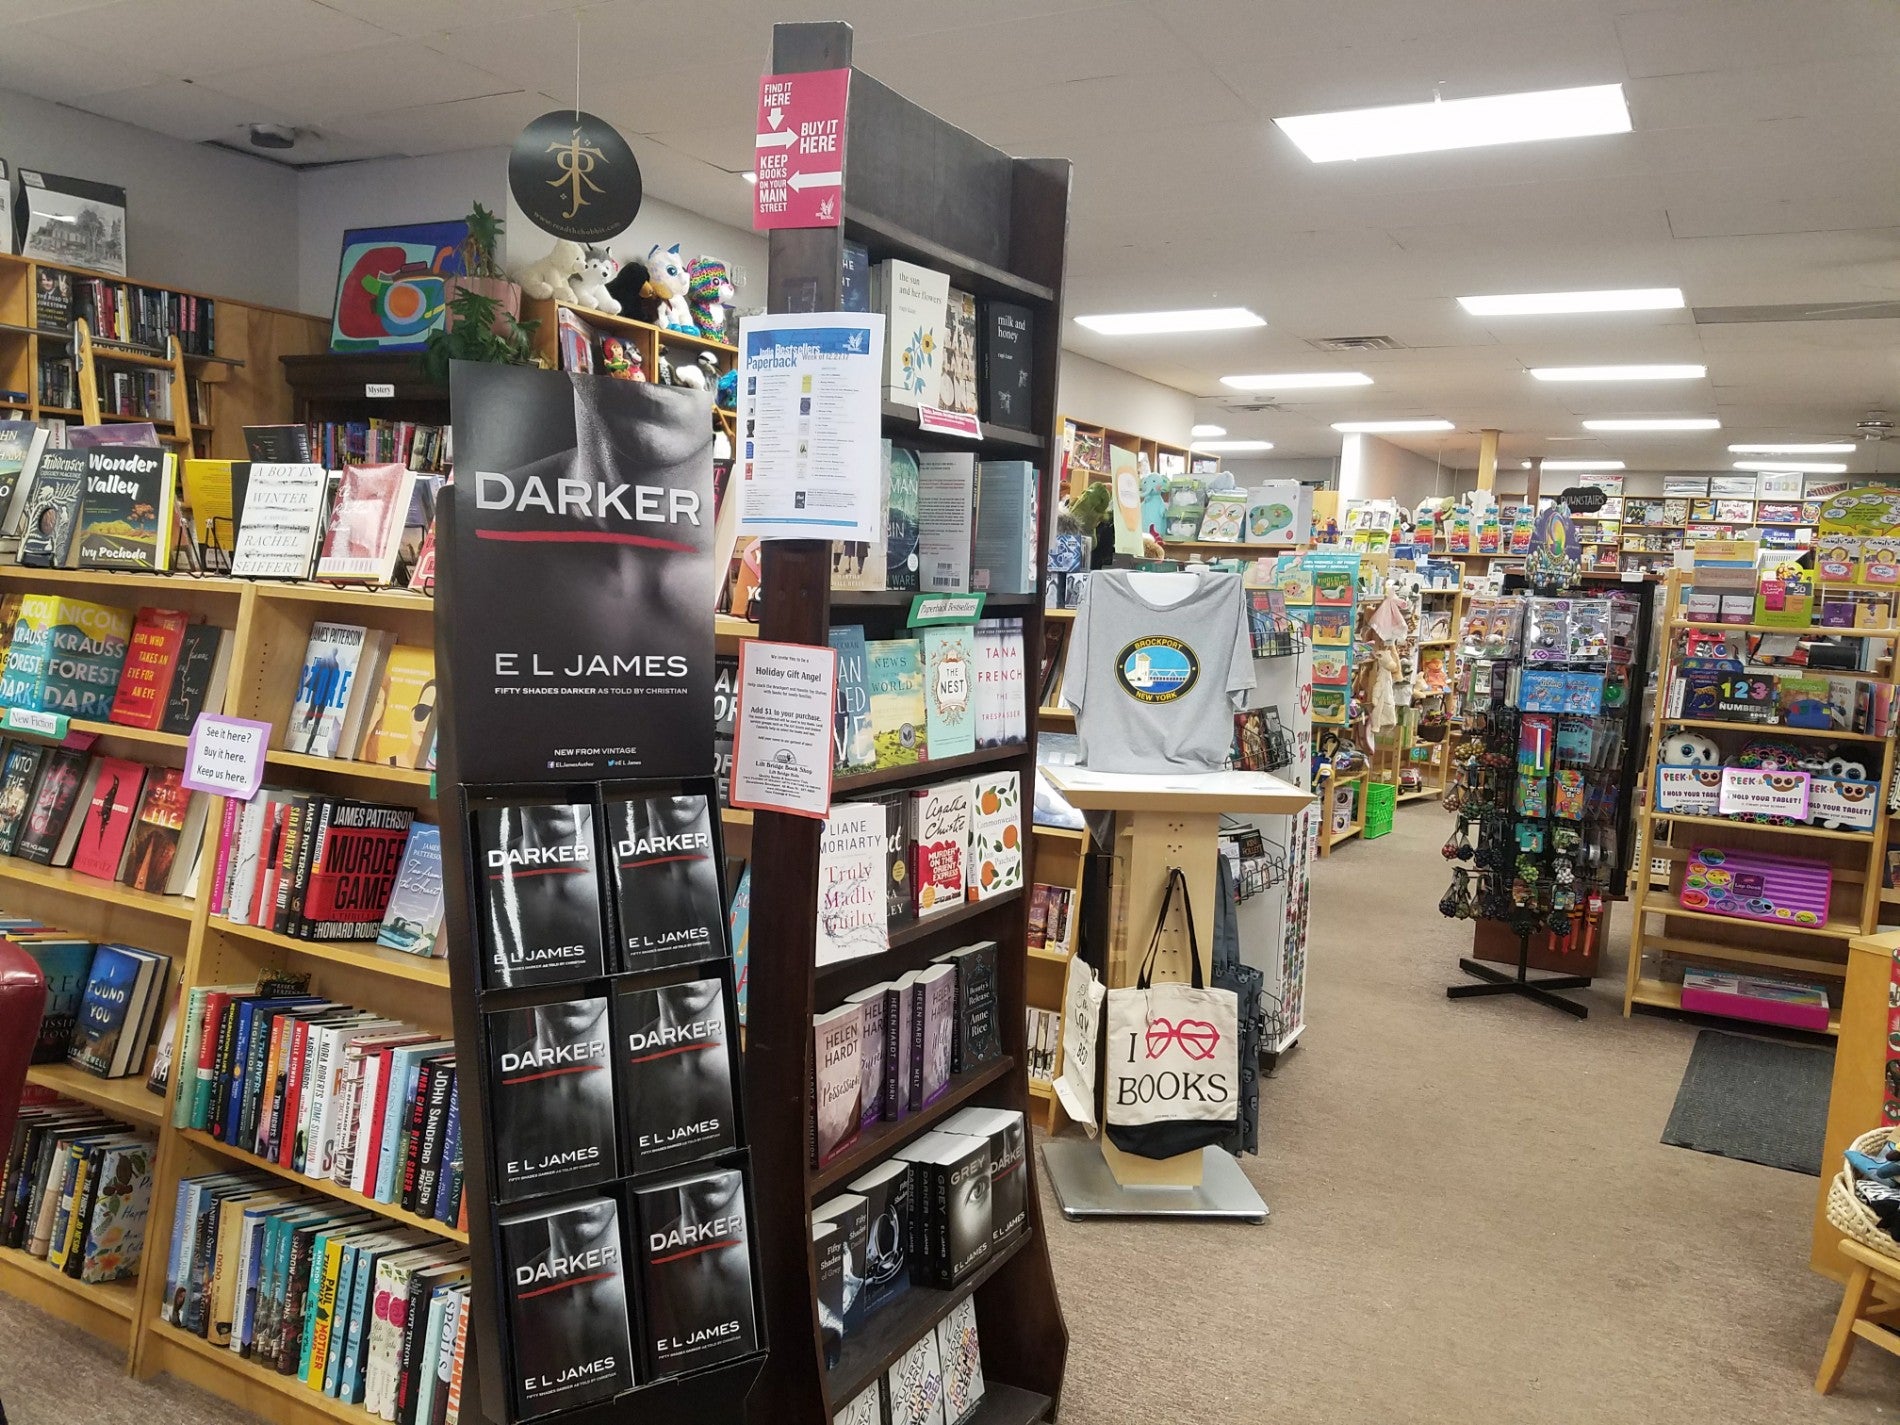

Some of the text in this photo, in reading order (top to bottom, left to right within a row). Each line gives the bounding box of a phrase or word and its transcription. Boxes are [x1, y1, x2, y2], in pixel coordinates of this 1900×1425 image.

[764, 82, 792, 94] FIND IT
[764, 93, 791, 107] HERE
[801, 120, 838, 136] BUY IT
[800, 134, 836, 154] HERE
[760, 154, 788, 168] KEEP
[760, 168, 787, 179] BOOKS
[760, 180, 786, 188] ON YOUR
[760, 188, 786, 203] MAIN
[760, 202, 787, 213] STREET
[900, 272, 920, 286] the sun
[998, 327, 1018, 343] honey
[747, 356, 797, 371] Paperback
[368, 386, 391, 394] Mystery
[89, 453, 157, 474] Wonder
[87, 475, 139, 500] Valley
[252, 493, 308, 504] WINTER
[475, 472, 700, 526] DARKER
[1561, 495, 1605, 506] DOWNSTAIRS
[244, 536, 299, 546] RACHEL
[81, 547, 146, 562] Ivy Pochoda
[233, 562, 300, 574] SEIFFERT
[921, 602, 976, 614] Paperback Bestsellers
[54, 632, 124, 658] KRAUSS
[311, 628, 362, 646] JAMES PATTERSON
[1134, 638, 1184, 649] BROCKPORT
[986, 647, 1016, 659] TANA
[496, 654, 688, 677] E L JAMES
[874, 657, 907, 668] NEWS
[48, 658, 120, 686] FOREST
[127, 668, 154, 681] EYE FOR
[756, 667, 822, 683] Holiday Gift Angel
[946, 668, 959, 676] THE
[978, 670, 1023, 682] FRENCH
[131, 686, 156, 700] AN EYE
[871, 680, 912, 692] WORLD
[940, 679, 965, 694] NEST
[43, 686, 112, 716] DARK
[1136, 690, 1177, 701] NEW YORK
[751, 706, 763, 714] Add
[795, 712, 821, 722] purchase.
[982, 711, 1021, 721] TRESPASSER
[1719, 702, 1768, 713] NUMBERS
[12, 710, 54, 730] New Fiction
[206, 727, 251, 743] See it here?
[204, 747, 246, 762] Buy it here.
[197, 766, 246, 784] Keep us here.
[1562, 785, 1581, 794] Crazy
[1733, 793, 1749, 801] HOLD
[1772, 796, 1801, 805] TABLET!
[334, 806, 414, 830] JAMES PATTERSON
[830, 820, 866, 836] LIANE
[285, 807, 300, 870] SARA PARETSKY
[295, 803, 315, 889] JAMES PATTERSON
[618, 832, 709, 857] DARKER
[820, 836, 881, 854] MORIARTY
[488, 845, 590, 867] DARKER
[928, 849, 955, 860] MURDER
[825, 861, 872, 883] Truly
[933, 864, 956, 873] ORIENT
[276, 878, 289, 909] FALLOUT
[1735, 882, 1746, 890] Lap
[825, 886, 875, 910] Madly
[823, 910, 876, 932] Guilty
[628, 927, 709, 948] E L JAMES
[493, 945, 585, 964] E L JAMES
[88, 980, 124, 1004] FOUND
[969, 992, 990, 1005] Release
[90, 1005, 111, 1023] YOU
[970, 1010, 988, 1025] Anne
[629, 1019, 722, 1051] DARKER
[825, 1022, 858, 1050] HELEN
[971, 1022, 988, 1038] Rice
[501, 1040, 606, 1072] DARKER
[825, 1039, 858, 1068] HARDT
[1128, 1033, 1138, 1062] I
[823, 1076, 860, 1107] Possession
[1117, 1072, 1228, 1105] BOOKS
[421, 1071, 448, 1164] JOHN SANDFORD
[404, 1067, 430, 1193] FINAL GIRLS RILEY SAGER
[639, 1119, 720, 1147] E L JAMES
[507, 1147, 599, 1174] E L JAMES
[417, 1168, 426, 1191] PREY
[951, 1155, 985, 1186] GREY
[422, 1170, 435, 1204] GOLDEN
[650, 1215, 743, 1252] DARKER
[516, 1245, 618, 1286] DARKER
[820, 1256, 841, 1270] Shades
[325, 1279, 335, 1305] PAUL
[403, 1296, 417, 1368] SCOTT TUROW
[657, 1321, 740, 1352] E L JAMES
[314, 1324, 329, 1370] MOTHER
[525, 1357, 616, 1391] E L JAMES
